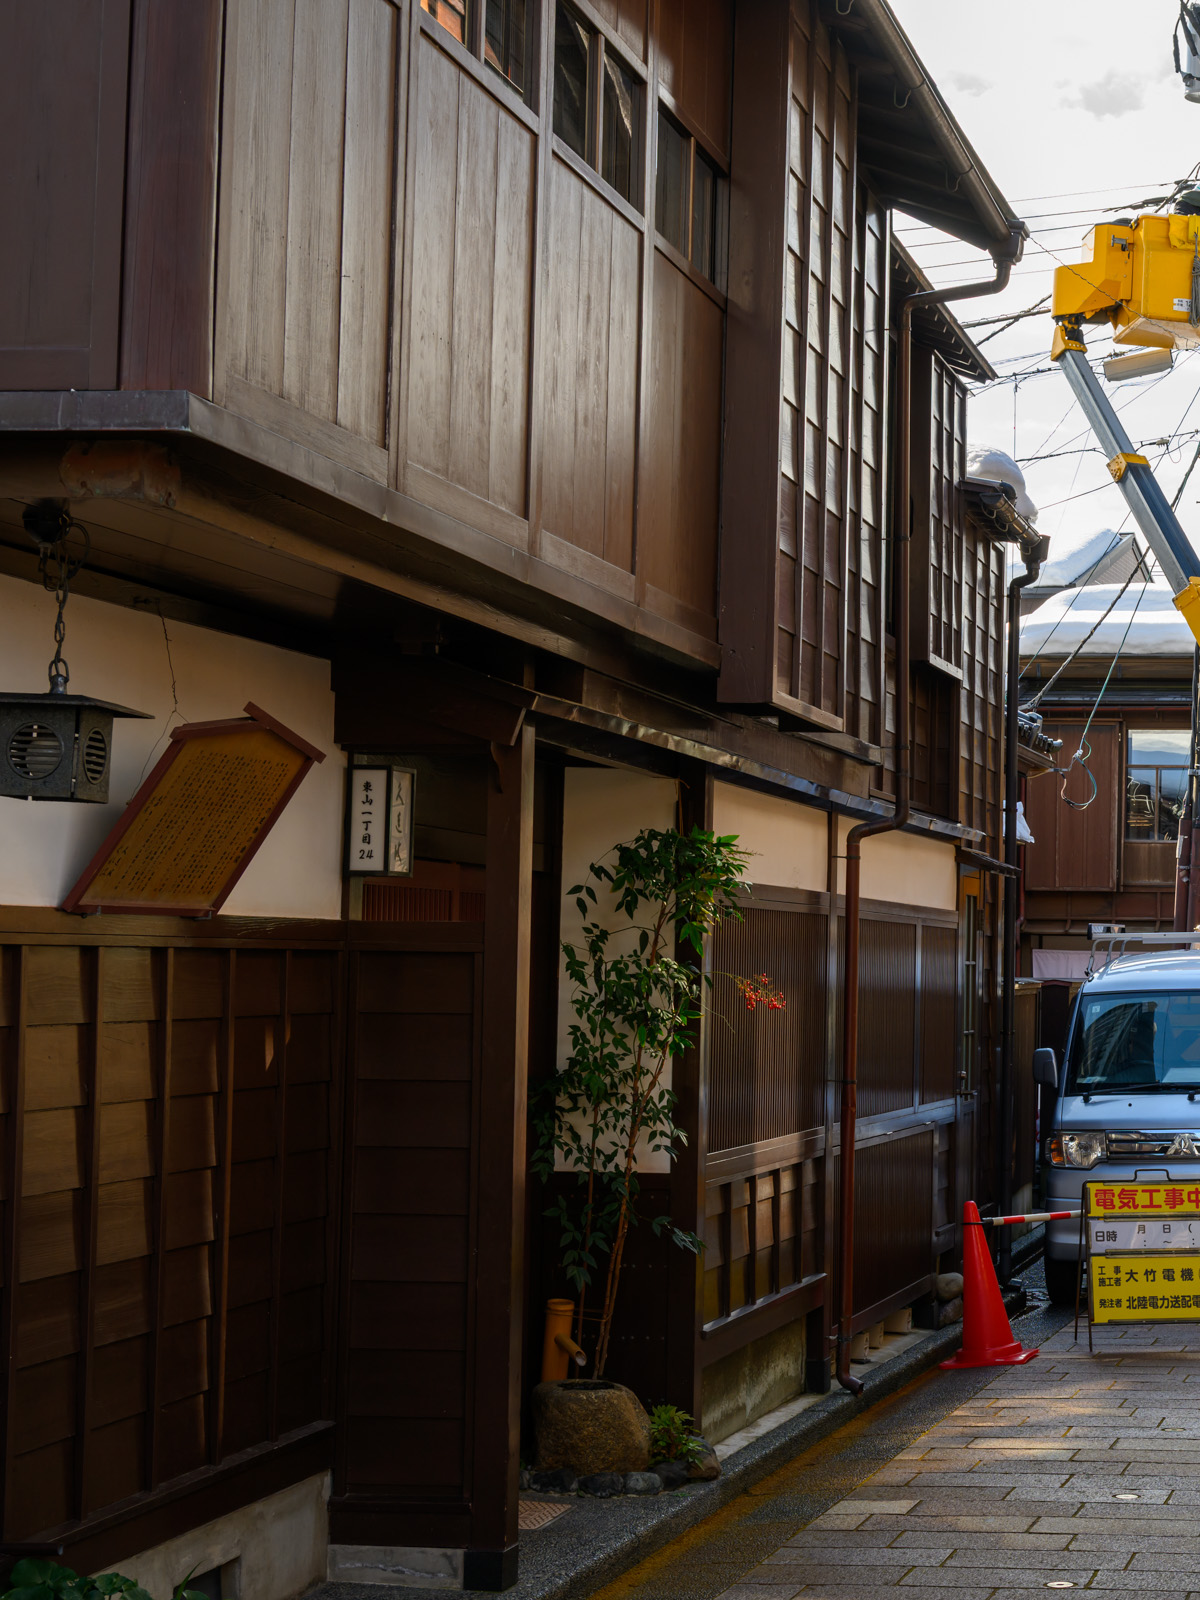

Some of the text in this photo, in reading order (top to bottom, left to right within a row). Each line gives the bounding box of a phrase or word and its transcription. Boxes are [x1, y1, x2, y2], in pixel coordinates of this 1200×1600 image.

[1137, 1224, 1146, 1234] 月
[1162, 1224, 1172, 1234] 日
[1095, 1230, 1118, 1242] 日時
[1098, 1277, 1121, 1287] 施工者
[1098, 1298, 1122, 1309] 発注者
